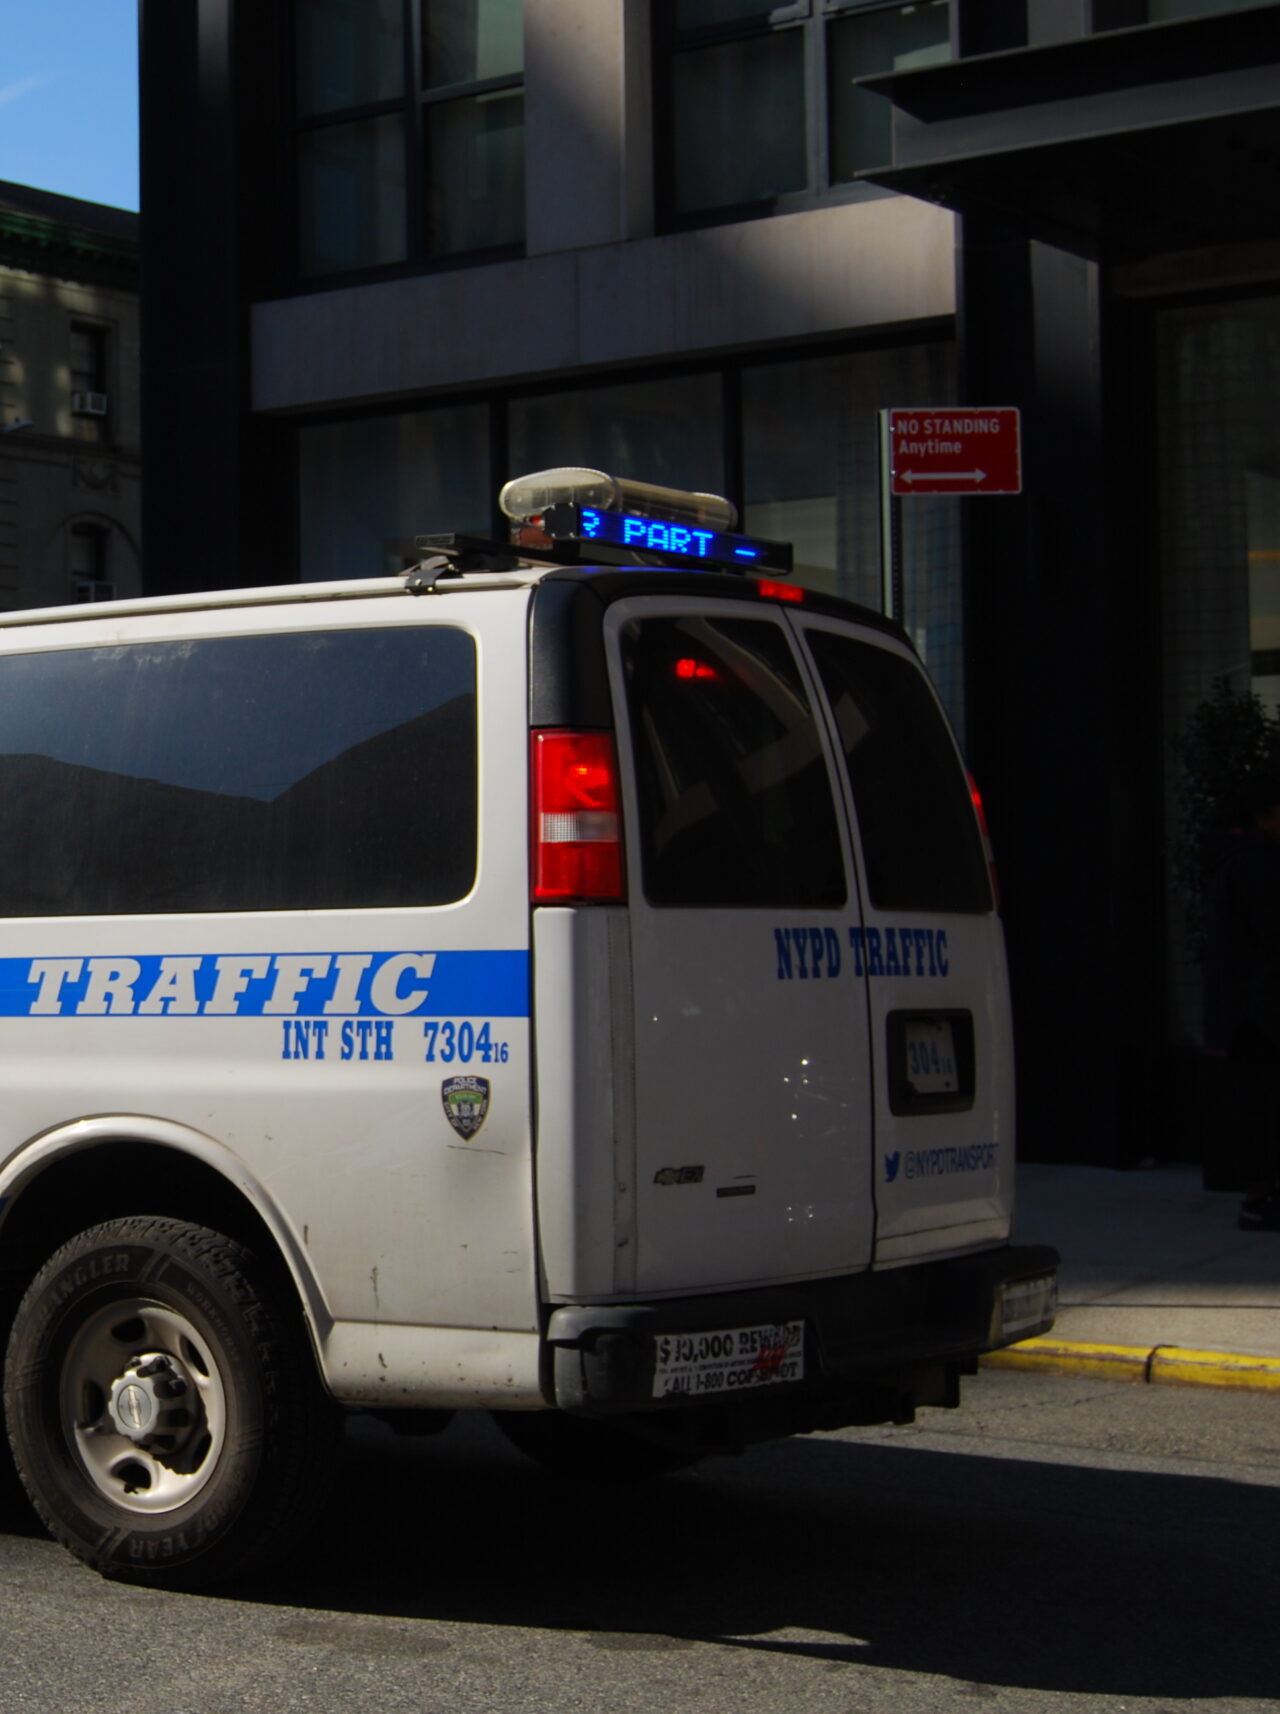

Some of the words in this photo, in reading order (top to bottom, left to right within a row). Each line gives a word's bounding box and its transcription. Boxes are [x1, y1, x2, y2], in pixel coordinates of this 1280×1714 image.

[897, 419, 919, 435] NO
[923, 418, 1001, 434] STANDING
[898, 439, 963, 458] Anytime
[623, 518, 714, 557] PART
[774, 927, 841, 979] NYPD
[849, 927, 949, 977] TRAFFIC
[26, 952, 437, 1016] TRAFFIC
[282, 1020, 328, 1060] INT
[341, 1020, 394, 1061] STH
